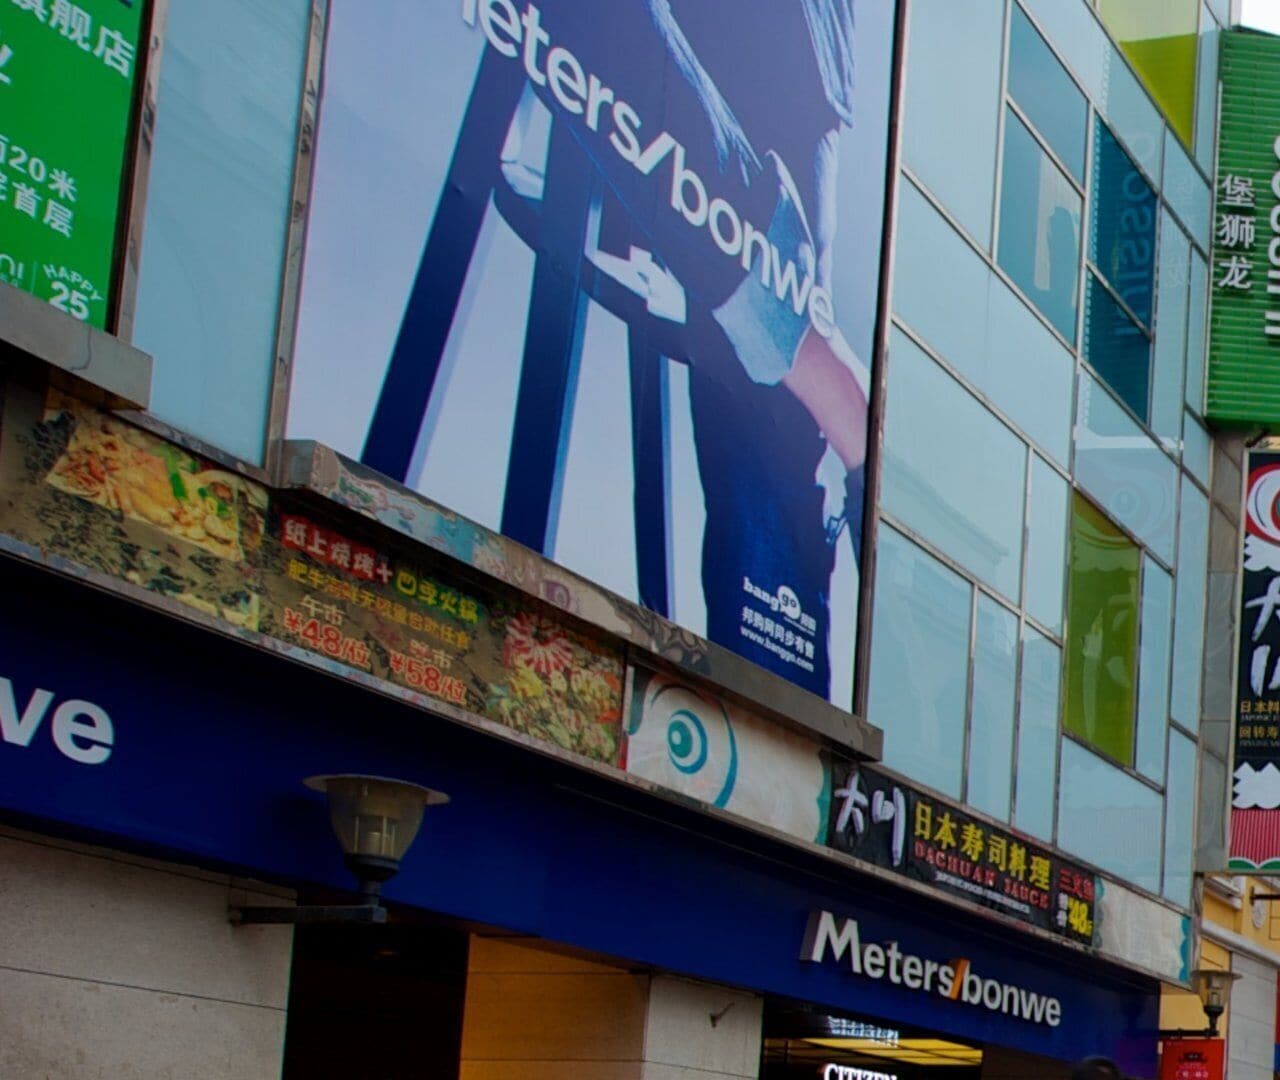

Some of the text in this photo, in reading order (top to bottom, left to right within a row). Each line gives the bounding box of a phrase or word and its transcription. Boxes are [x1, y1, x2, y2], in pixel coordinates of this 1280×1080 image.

[1217, 173, 1256, 290] 堡狮龙
[42, 263, 104, 303] HAPPY
[49, 281, 90, 321] 25
[914, 800, 1051, 893] 日本寿司料理
[809, 910, 1062, 1028] Meters/bonwe
